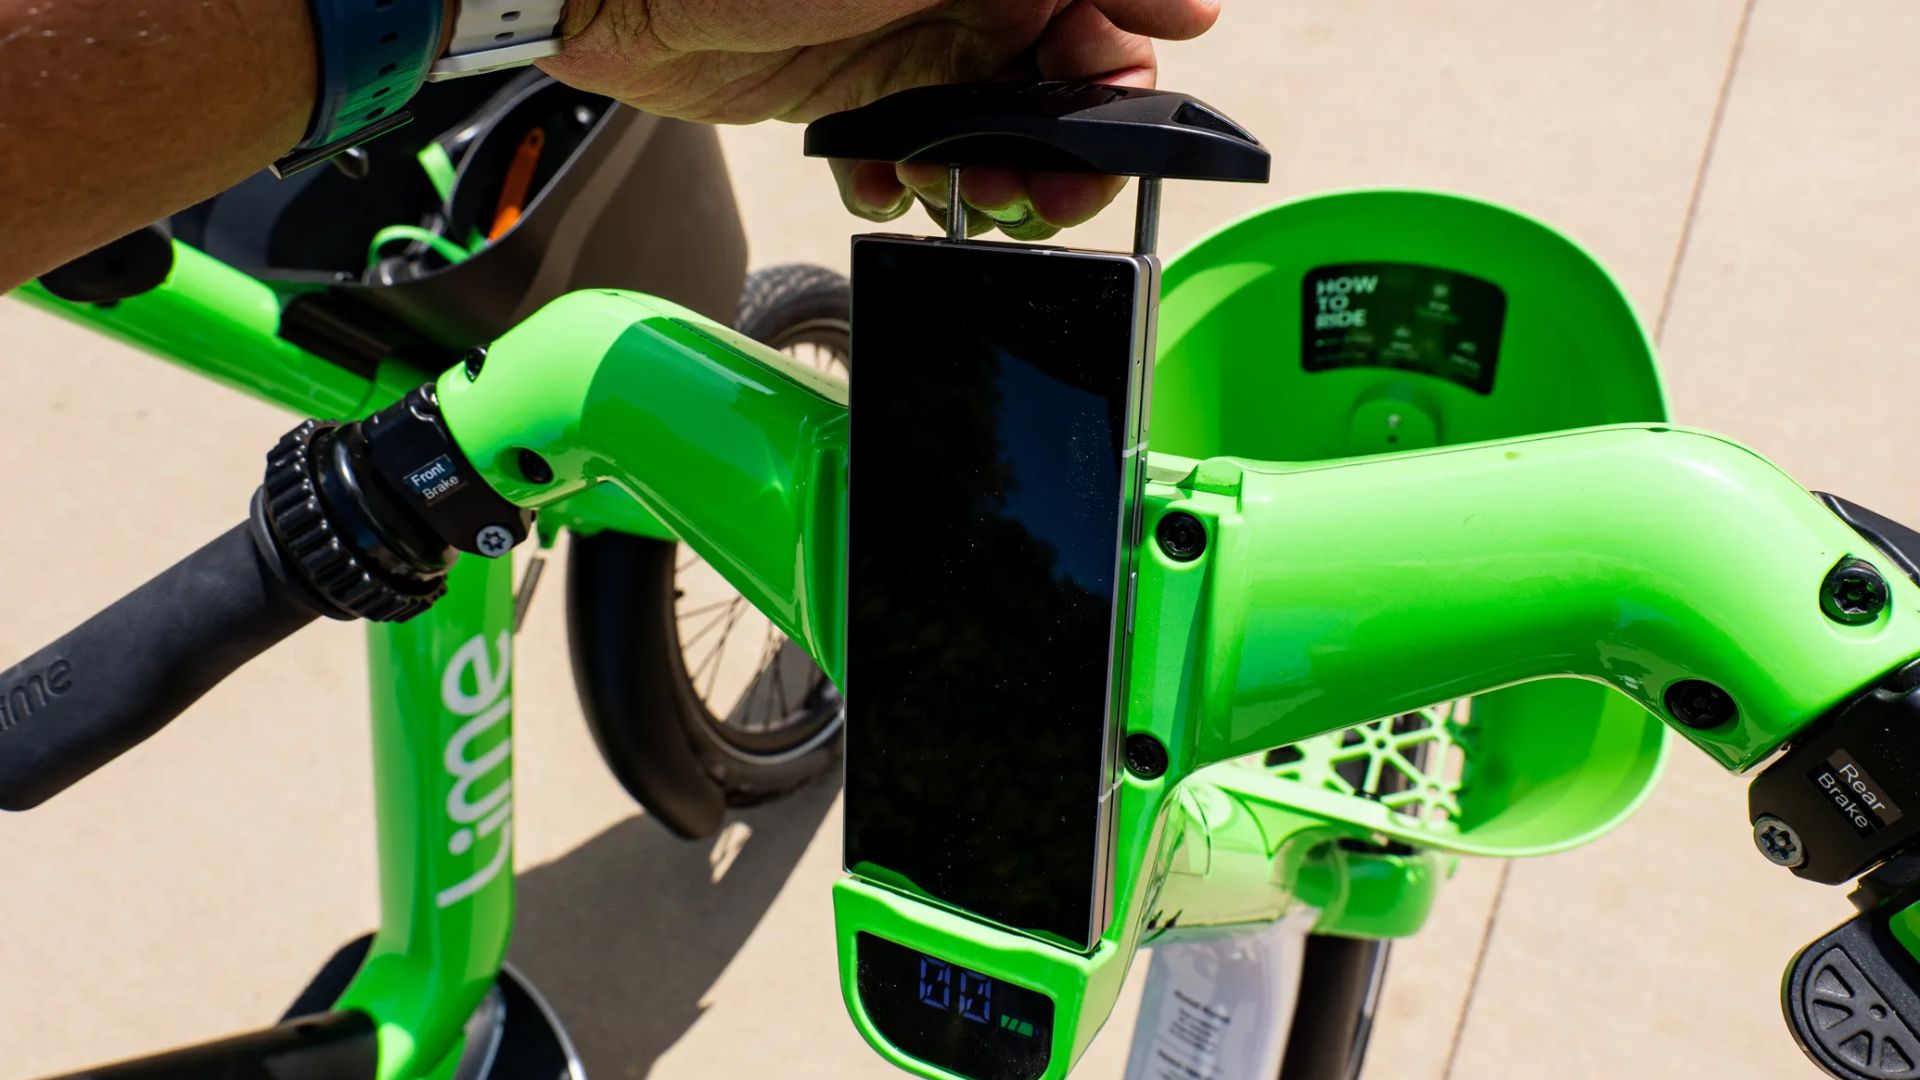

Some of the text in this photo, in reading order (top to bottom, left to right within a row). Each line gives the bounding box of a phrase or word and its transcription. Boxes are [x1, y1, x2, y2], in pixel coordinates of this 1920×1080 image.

[1315, 275, 1379, 295] HOW
[1316, 294, 1349, 312] TO
[1315, 308, 1367, 331] RIDE
[410, 462, 446, 487] Front
[422, 475, 459, 500] Brake
[0, 658, 73, 731] ime
[435, 628, 513, 909] Lime
[1839, 763, 1886, 810] Rear
[1818, 772, 1868, 828] Brake
